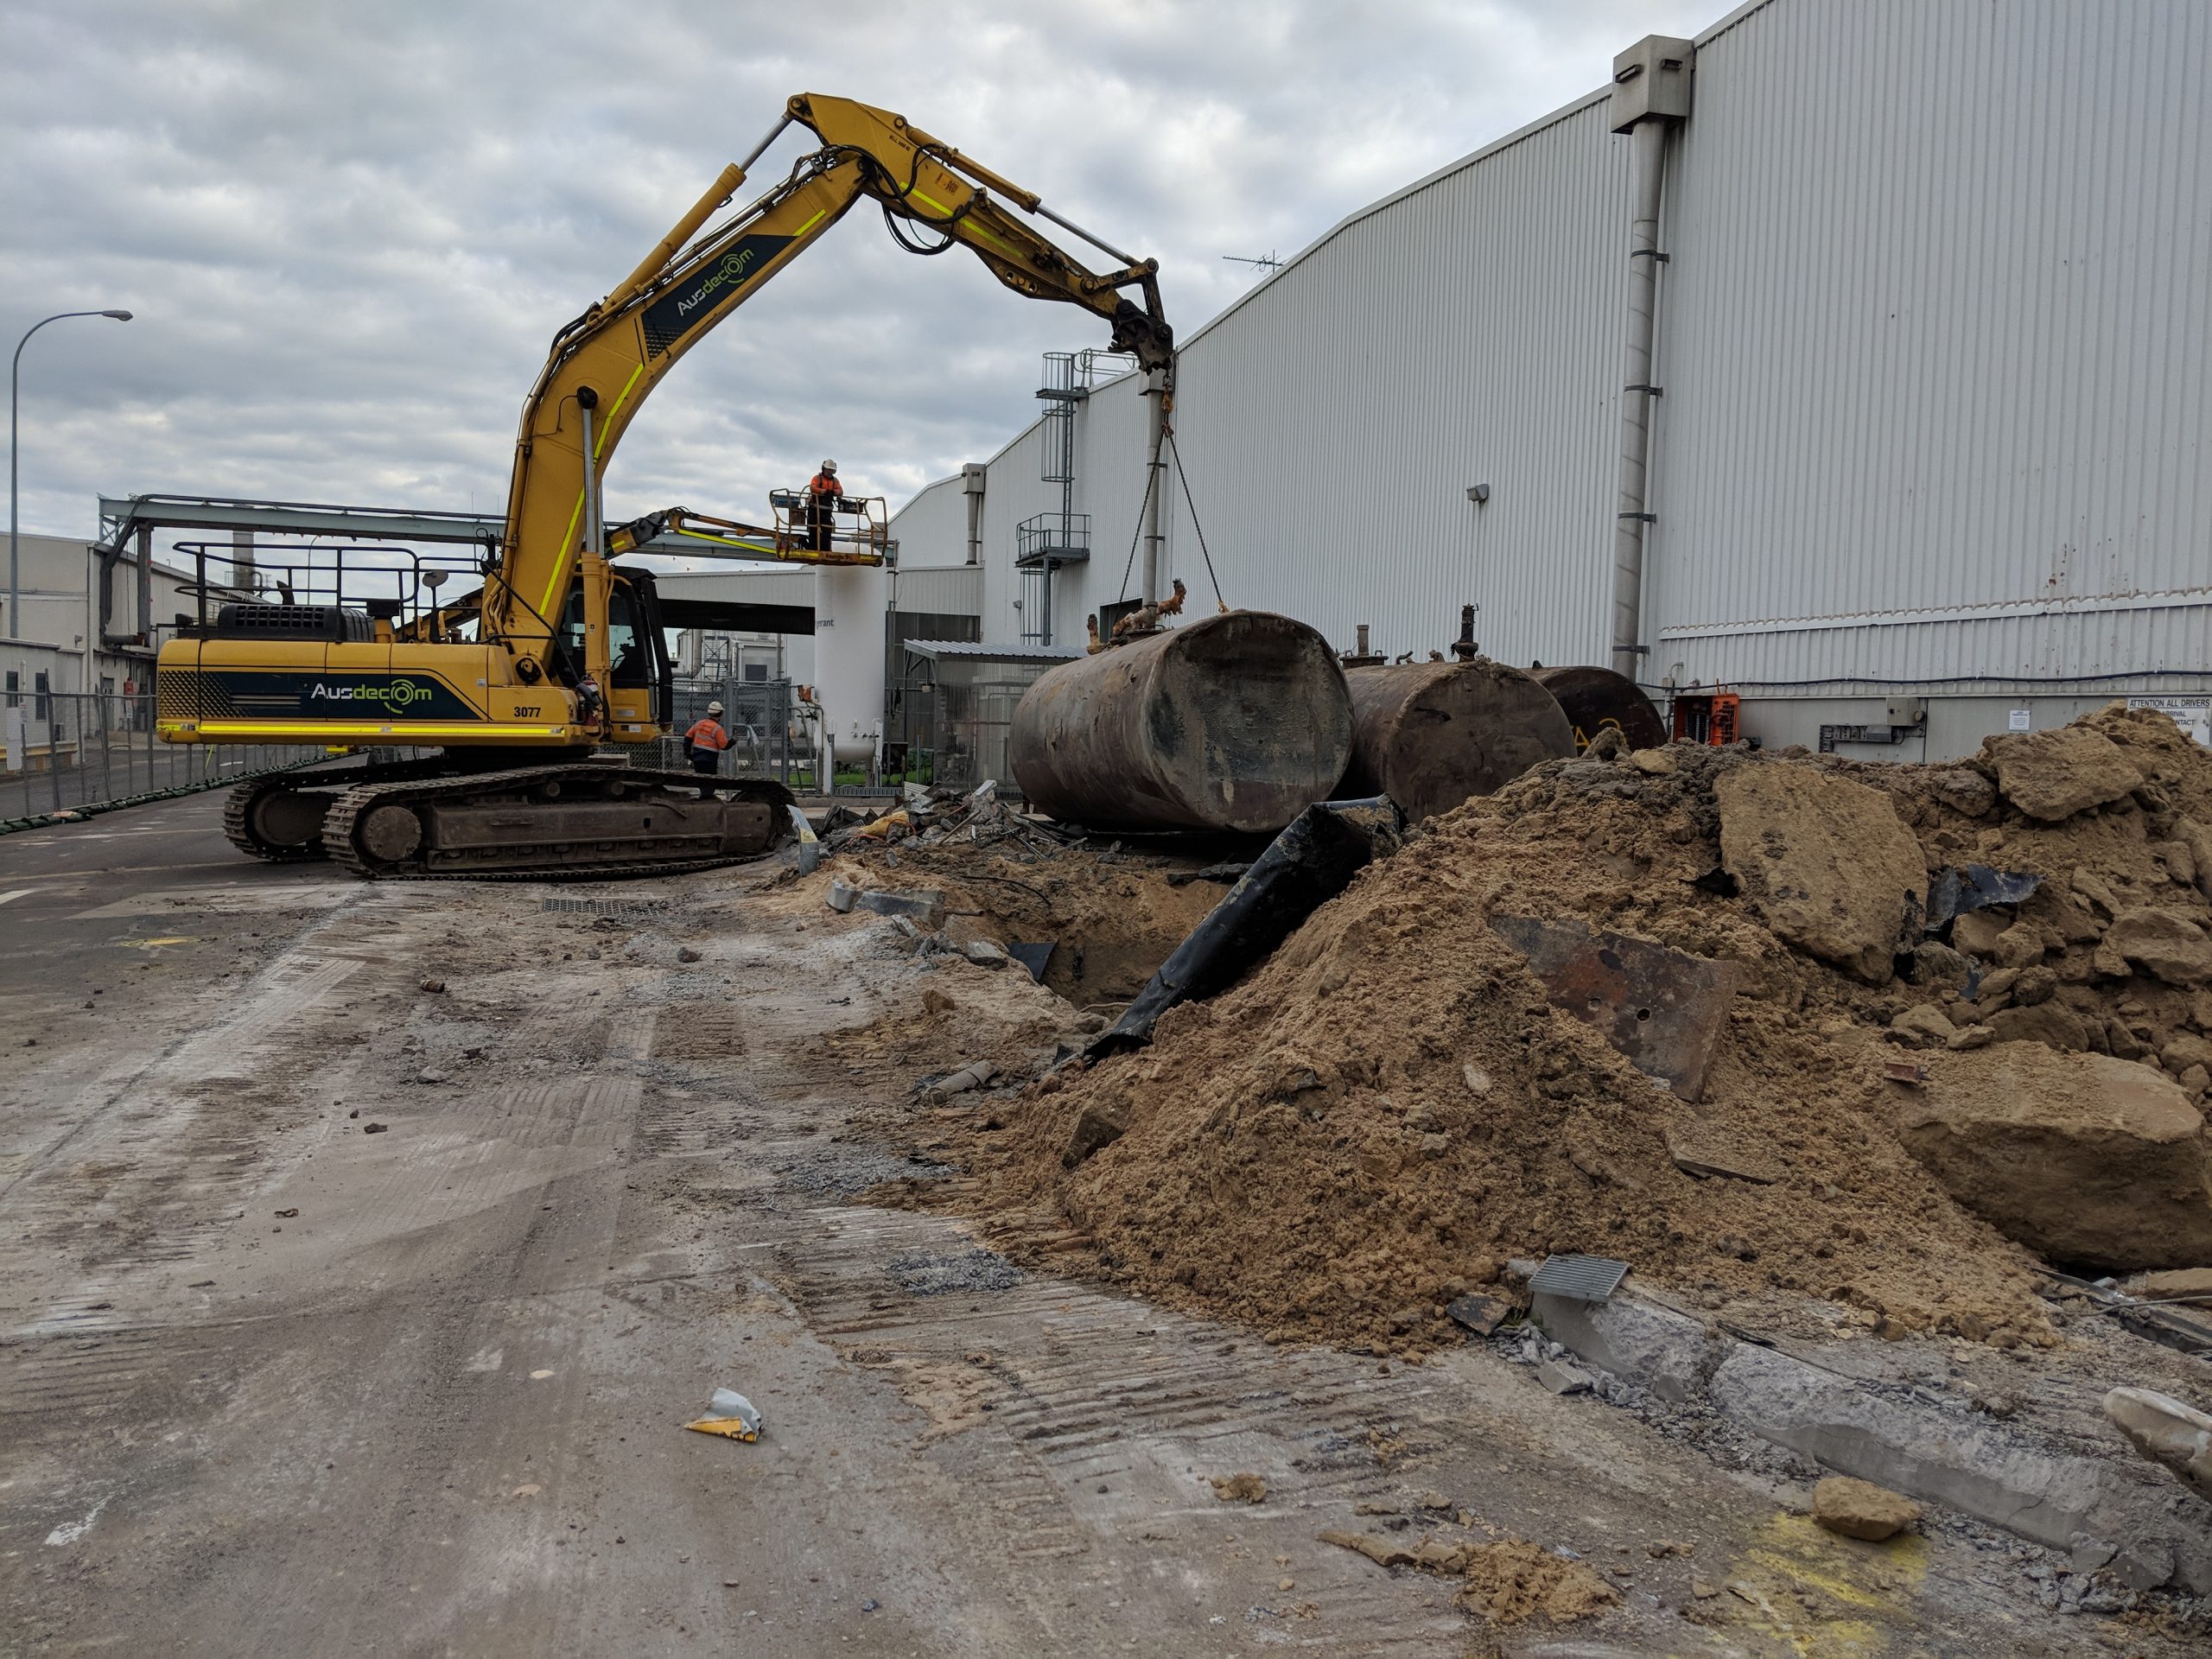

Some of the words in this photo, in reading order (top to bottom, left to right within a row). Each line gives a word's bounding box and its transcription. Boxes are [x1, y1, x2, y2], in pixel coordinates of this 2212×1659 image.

[677, 248, 754, 316] Ausdecom
[311, 679, 432, 709] Ausdecom
[2129, 699, 2164, 708] ATTENTION
[514, 707, 542, 718] 3077
